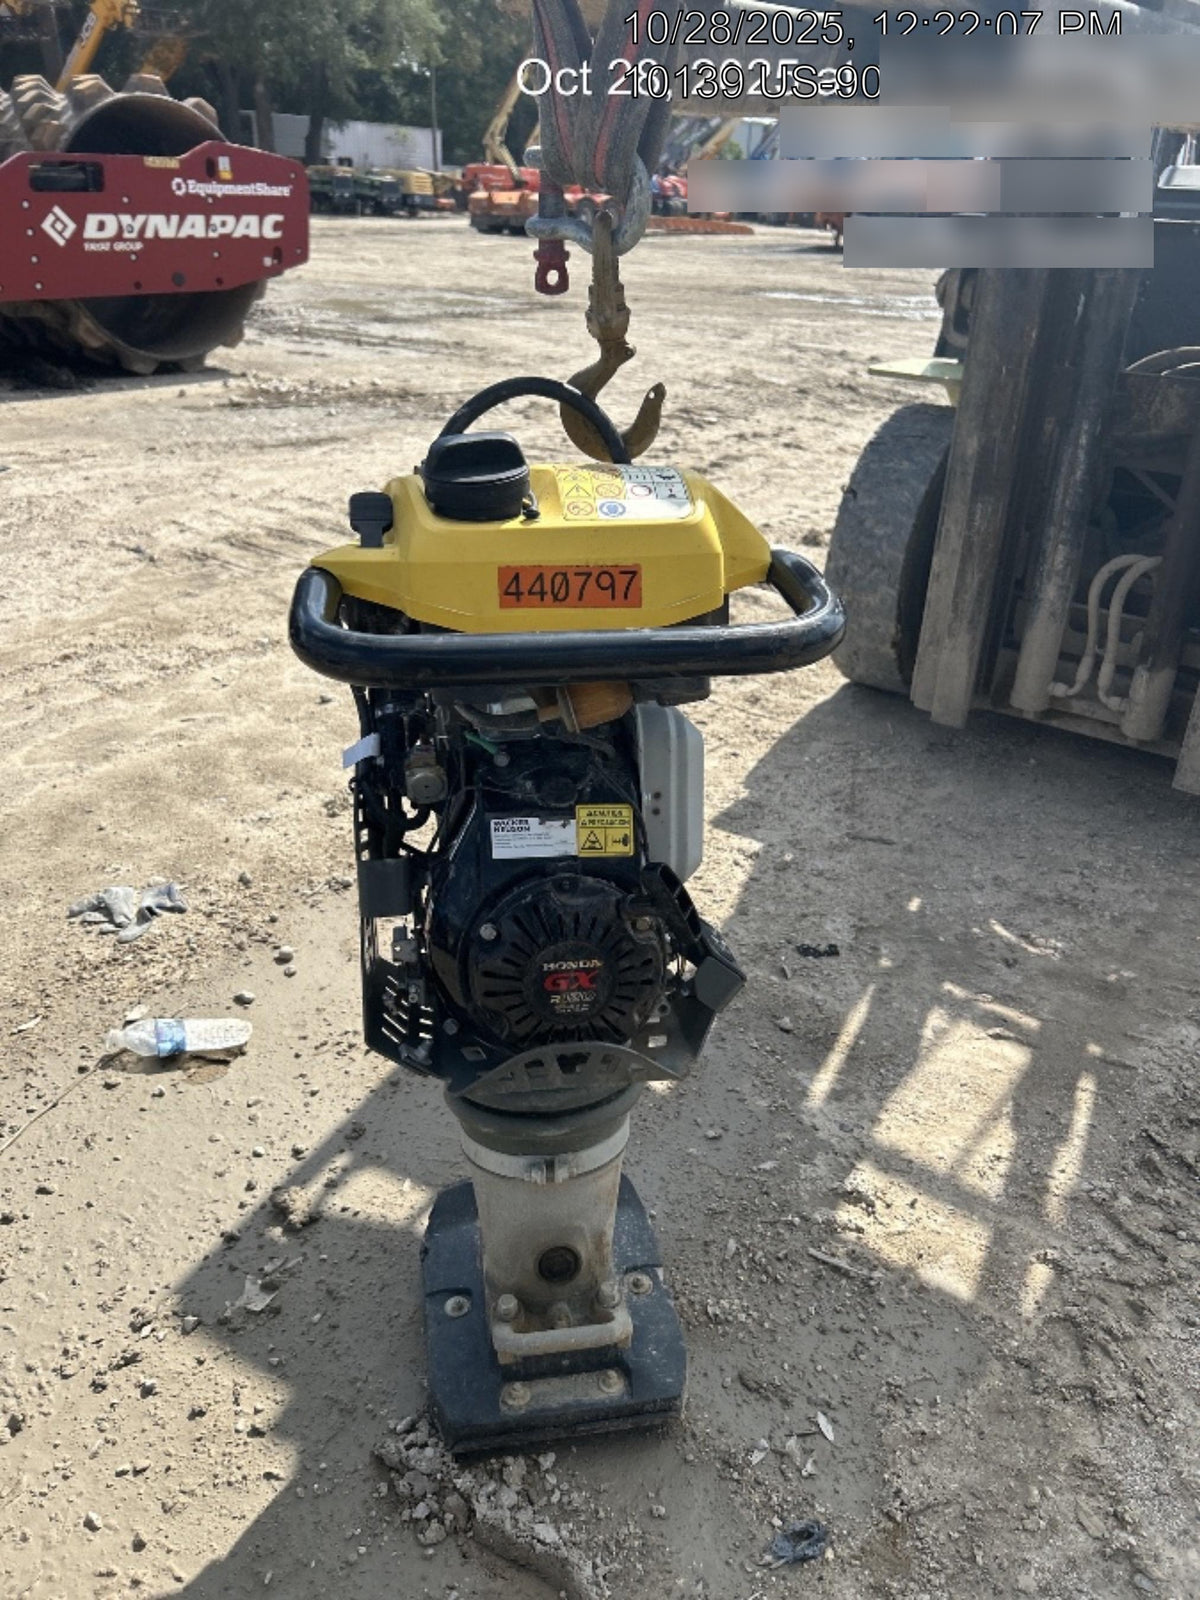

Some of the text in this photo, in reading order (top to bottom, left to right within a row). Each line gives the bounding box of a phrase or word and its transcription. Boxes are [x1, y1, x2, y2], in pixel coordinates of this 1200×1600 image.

[187, 179, 291, 198] EquipmentShare
[83, 213, 285, 239] DYNAPAC
[503, 570, 638, 602] 440797
[543, 960, 602, 971] HONDA
[543, 970, 598, 991] GX
